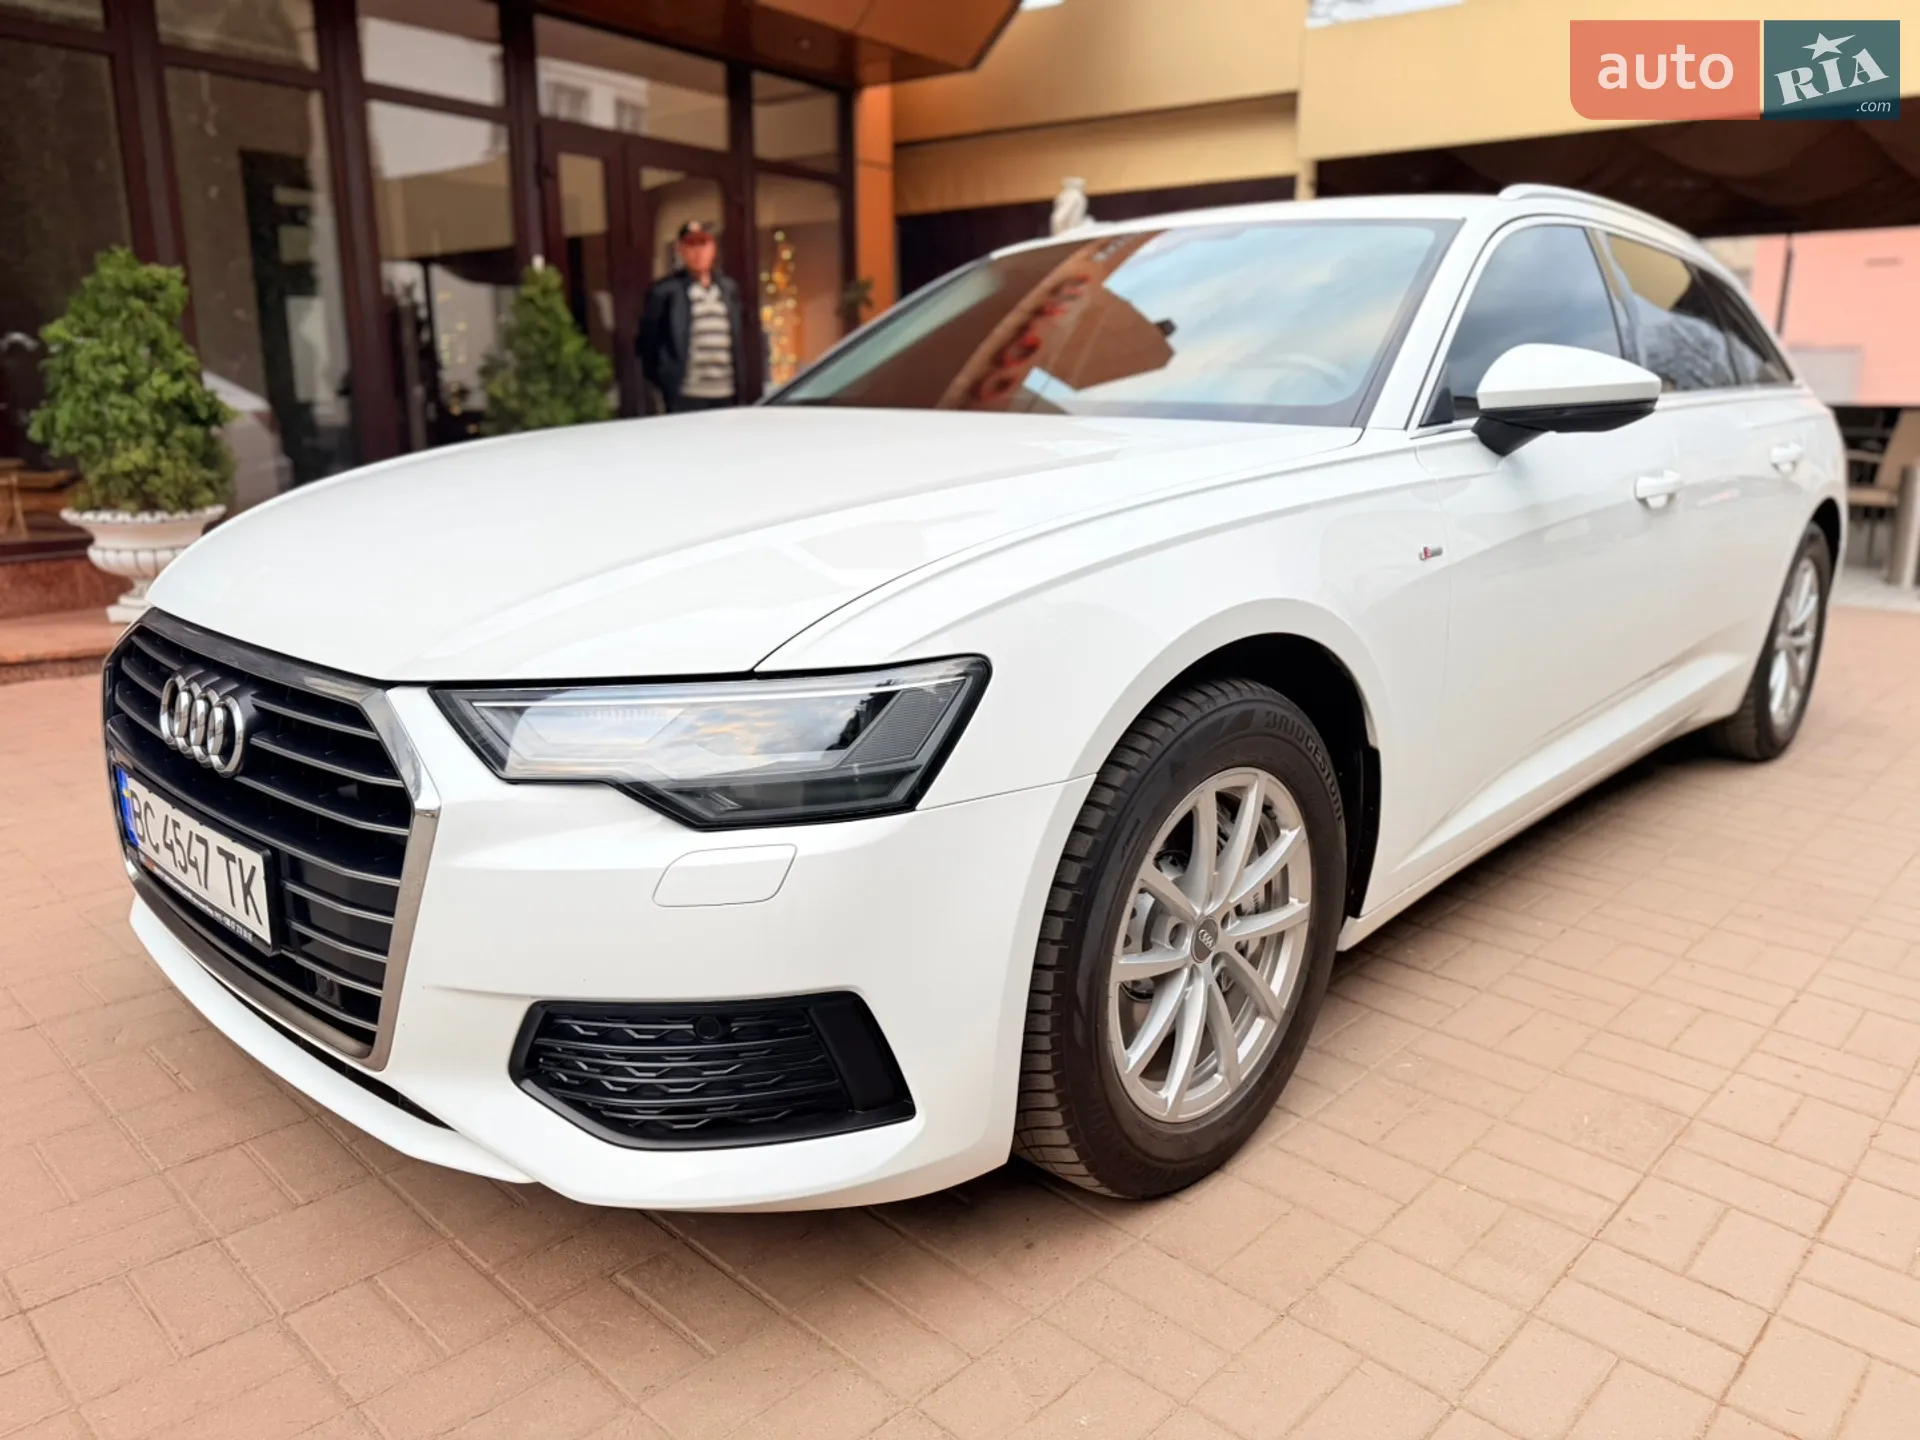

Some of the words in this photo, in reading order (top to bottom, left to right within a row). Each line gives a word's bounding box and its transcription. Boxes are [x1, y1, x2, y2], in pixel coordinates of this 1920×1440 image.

[130, 788, 160, 854] BC
[162, 813, 210, 891] 4547
[216, 845, 263, 926] TK
